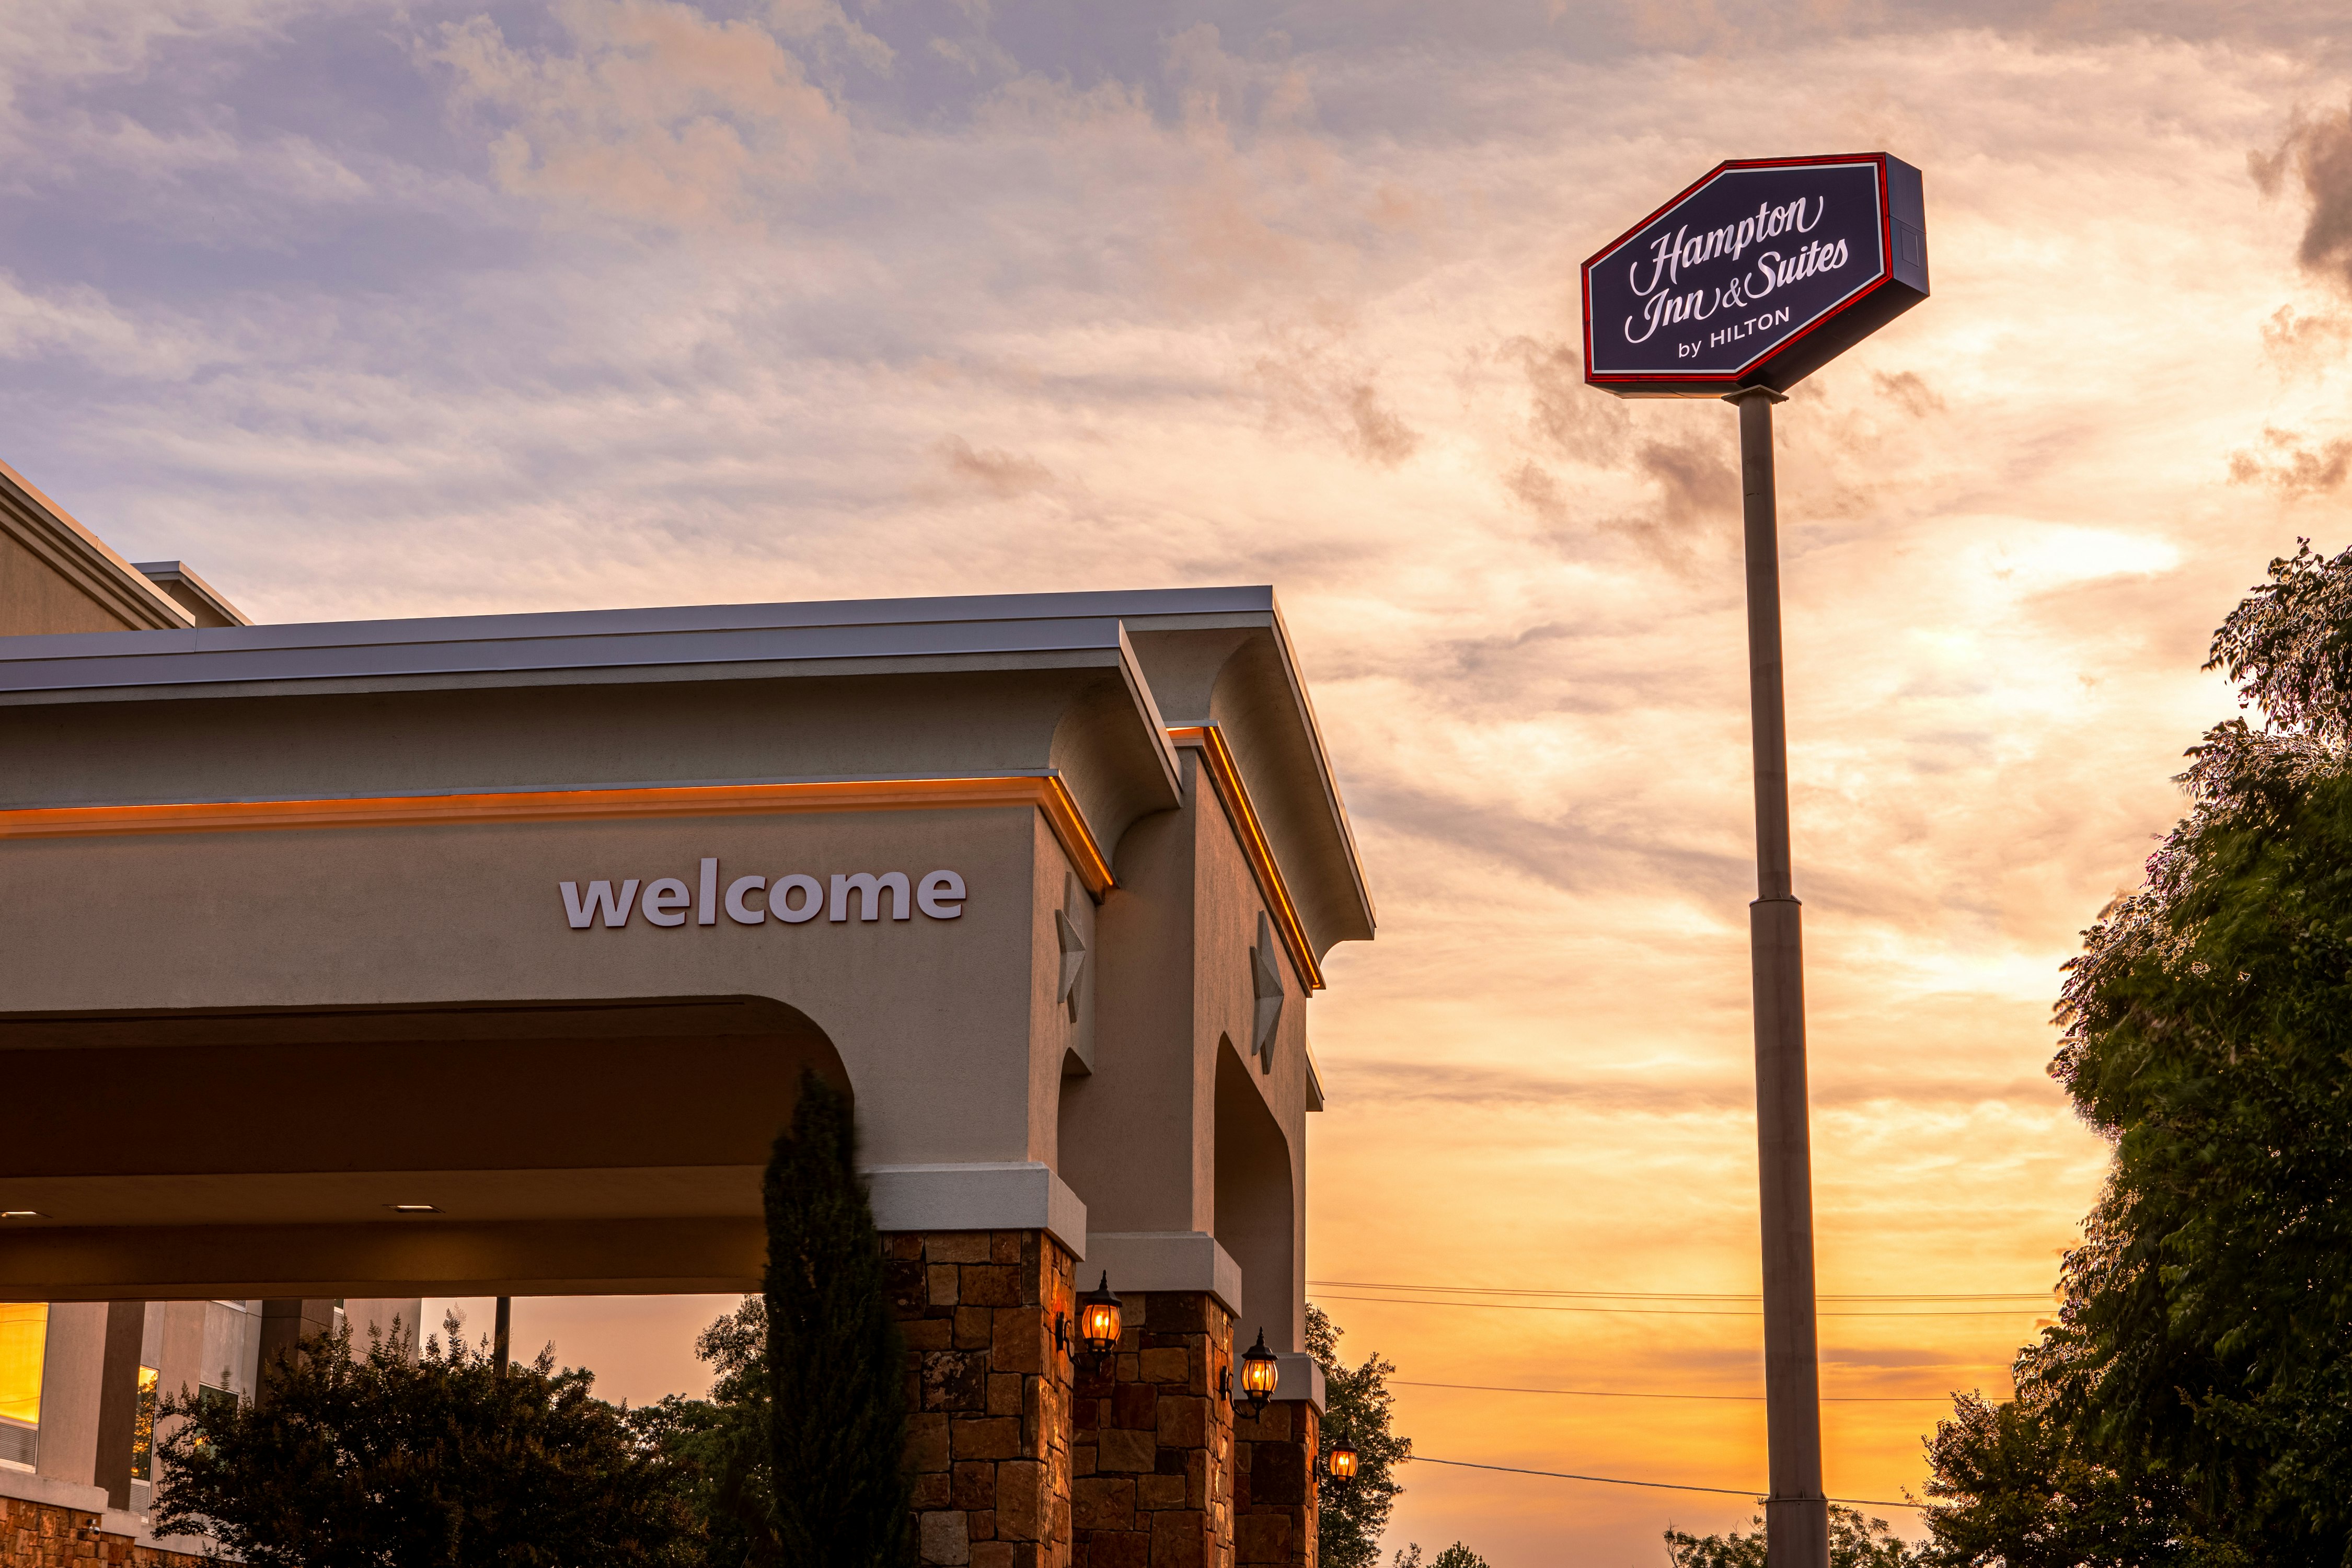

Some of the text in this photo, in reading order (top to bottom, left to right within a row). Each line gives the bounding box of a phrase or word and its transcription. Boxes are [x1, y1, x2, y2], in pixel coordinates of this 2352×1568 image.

[1629, 195, 1824, 296] Hampton
[1624, 238, 1849, 343] Inn & Suites
[1678, 306, 1790, 359] by HILTON
[559, 857, 967, 929] welcome
